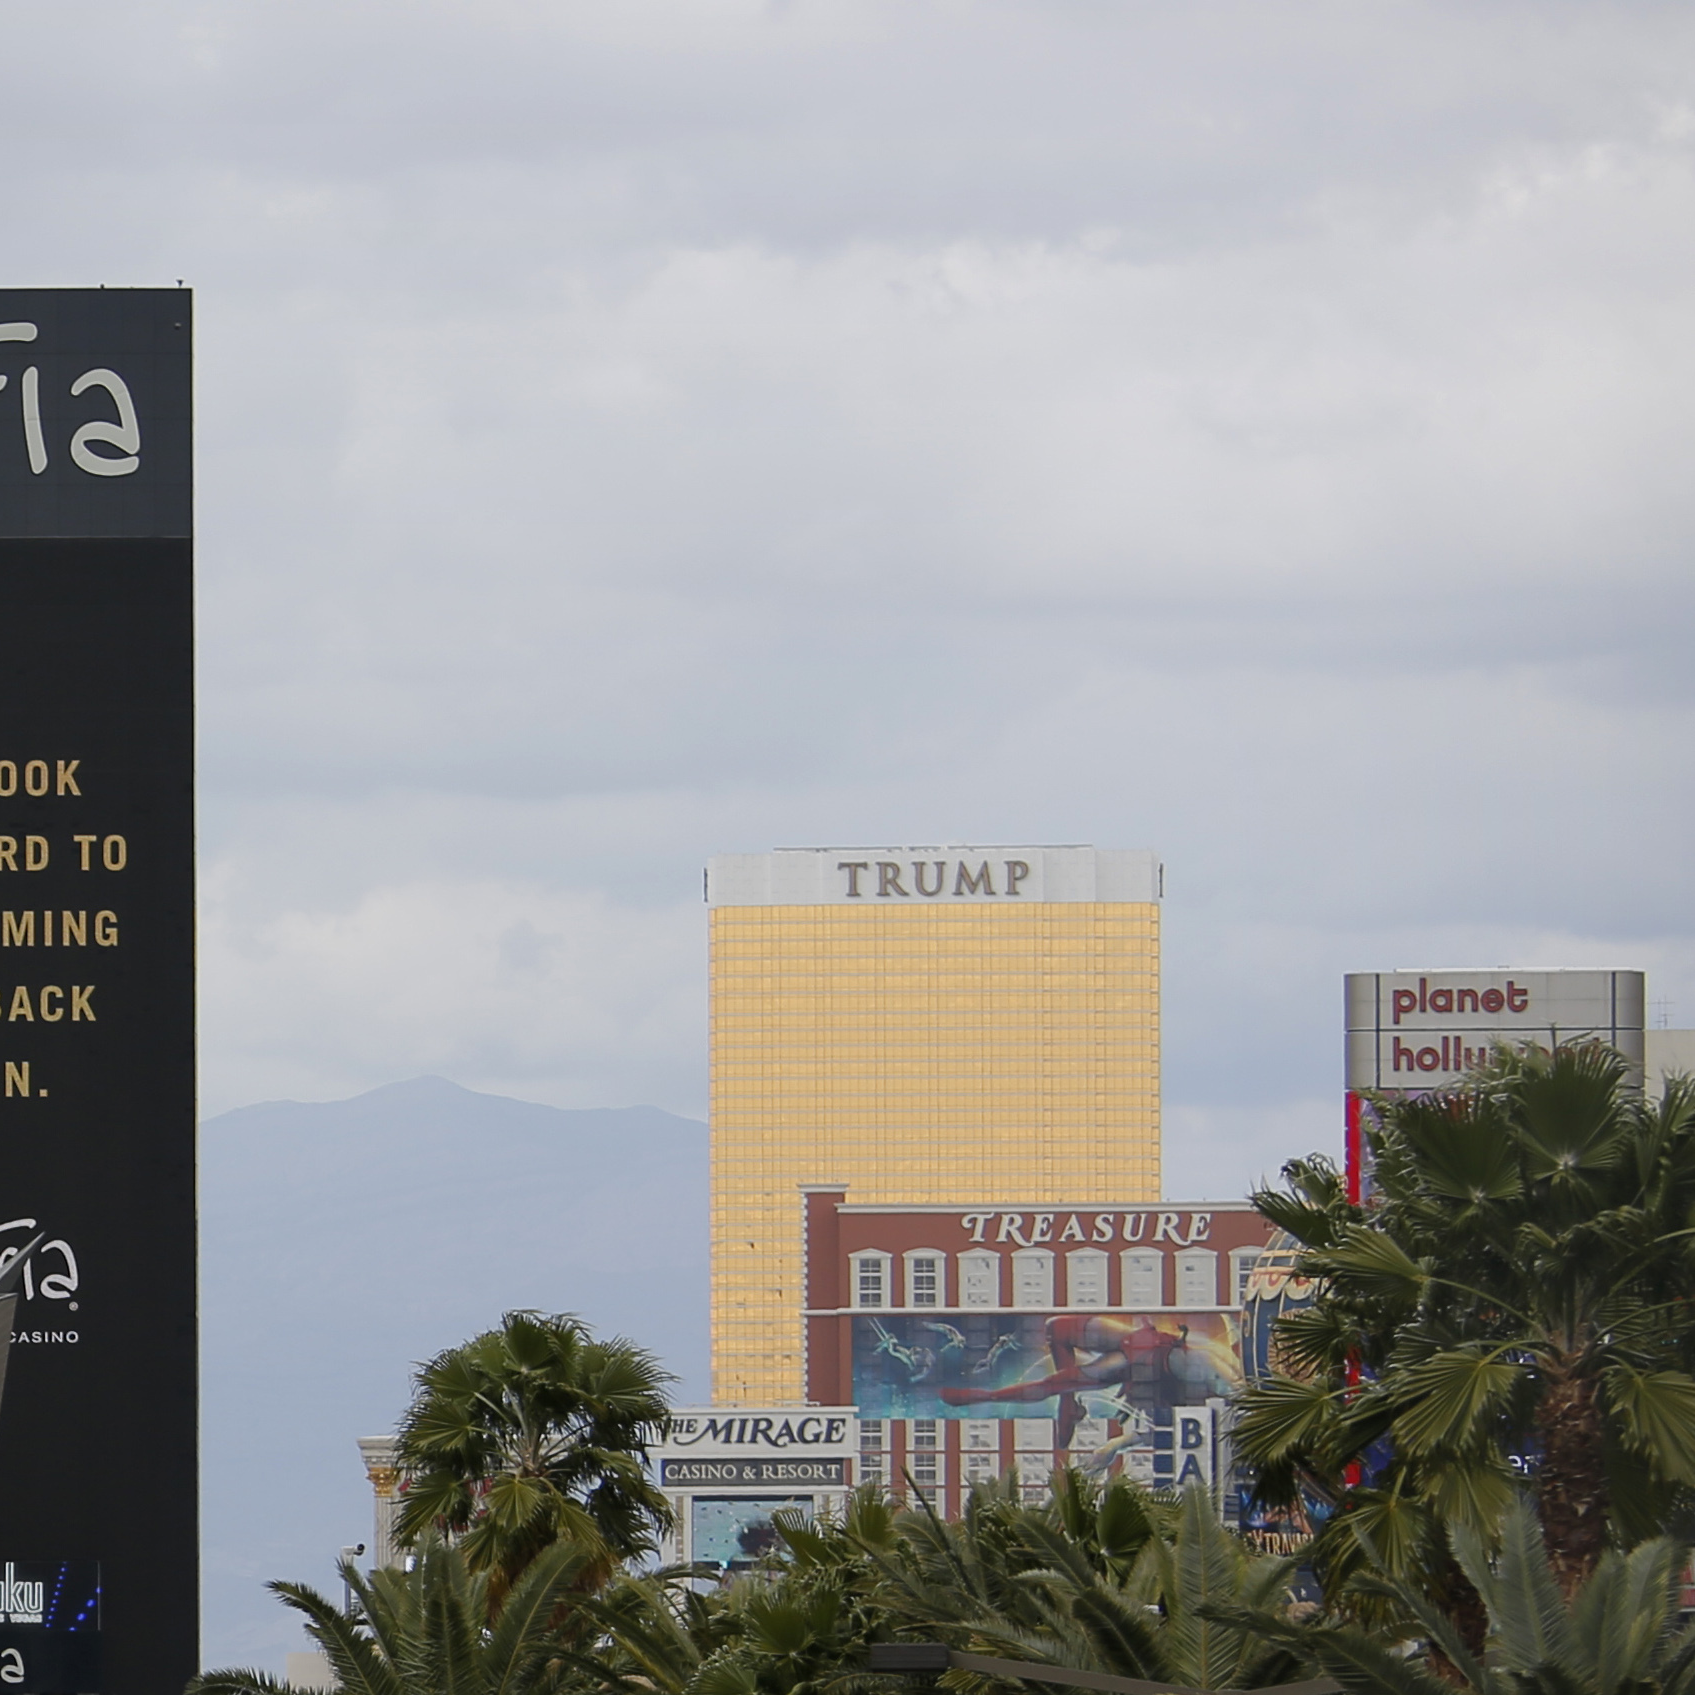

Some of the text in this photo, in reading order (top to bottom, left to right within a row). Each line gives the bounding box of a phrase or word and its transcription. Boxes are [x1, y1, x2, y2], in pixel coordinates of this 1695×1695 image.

[73, 833, 128, 873] TO
[837, 860, 1031, 899] TRUMP
[1392, 977, 1529, 1025] planet
[961, 1212, 1212, 1248] TREASURE
[669, 1416, 847, 1448] HE MIRAGE
[664, 1463, 841, 1480] CASINO & RESORT
